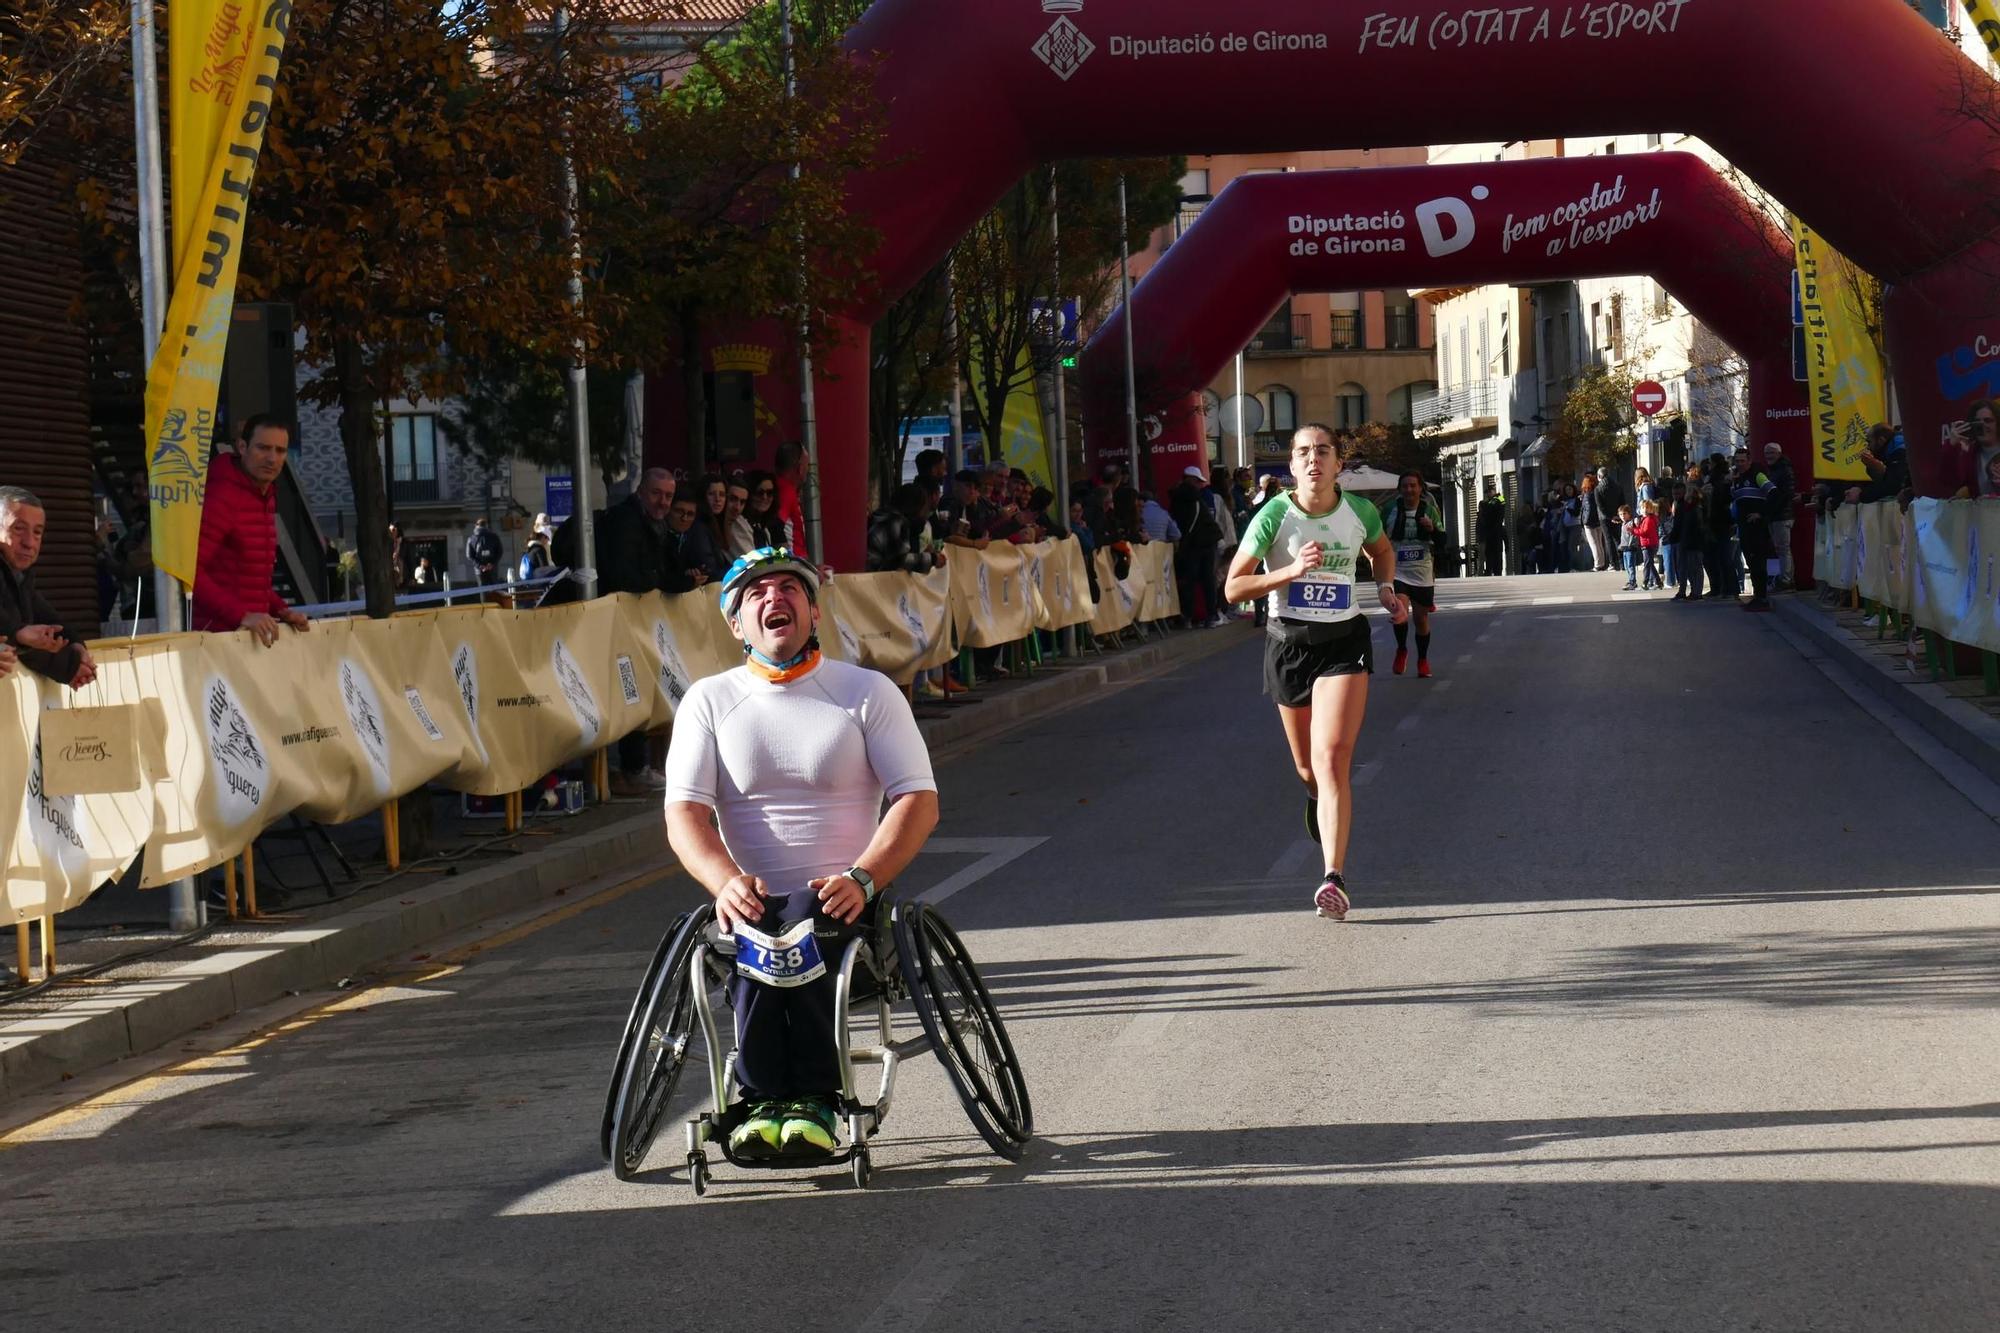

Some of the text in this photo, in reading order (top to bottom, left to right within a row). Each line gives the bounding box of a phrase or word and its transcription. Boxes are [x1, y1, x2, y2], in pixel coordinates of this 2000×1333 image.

[1358, 0, 1692, 54] FEM COSTAT A L'ESPORT
[1109, 30, 1328, 60] Diputació de Girona
[1288, 210, 1405, 237] Diputació
[1502, 174, 1627, 254] fem costat
[1546, 188, 1663, 257] a l'esport
[1289, 236, 1406, 256] de Girona
[1167, 442, 1198, 453] Girona
[1303, 584, 1337, 602] 875
[753, 943, 804, 970] 758
[762, 965, 797, 976] CYRILLE
